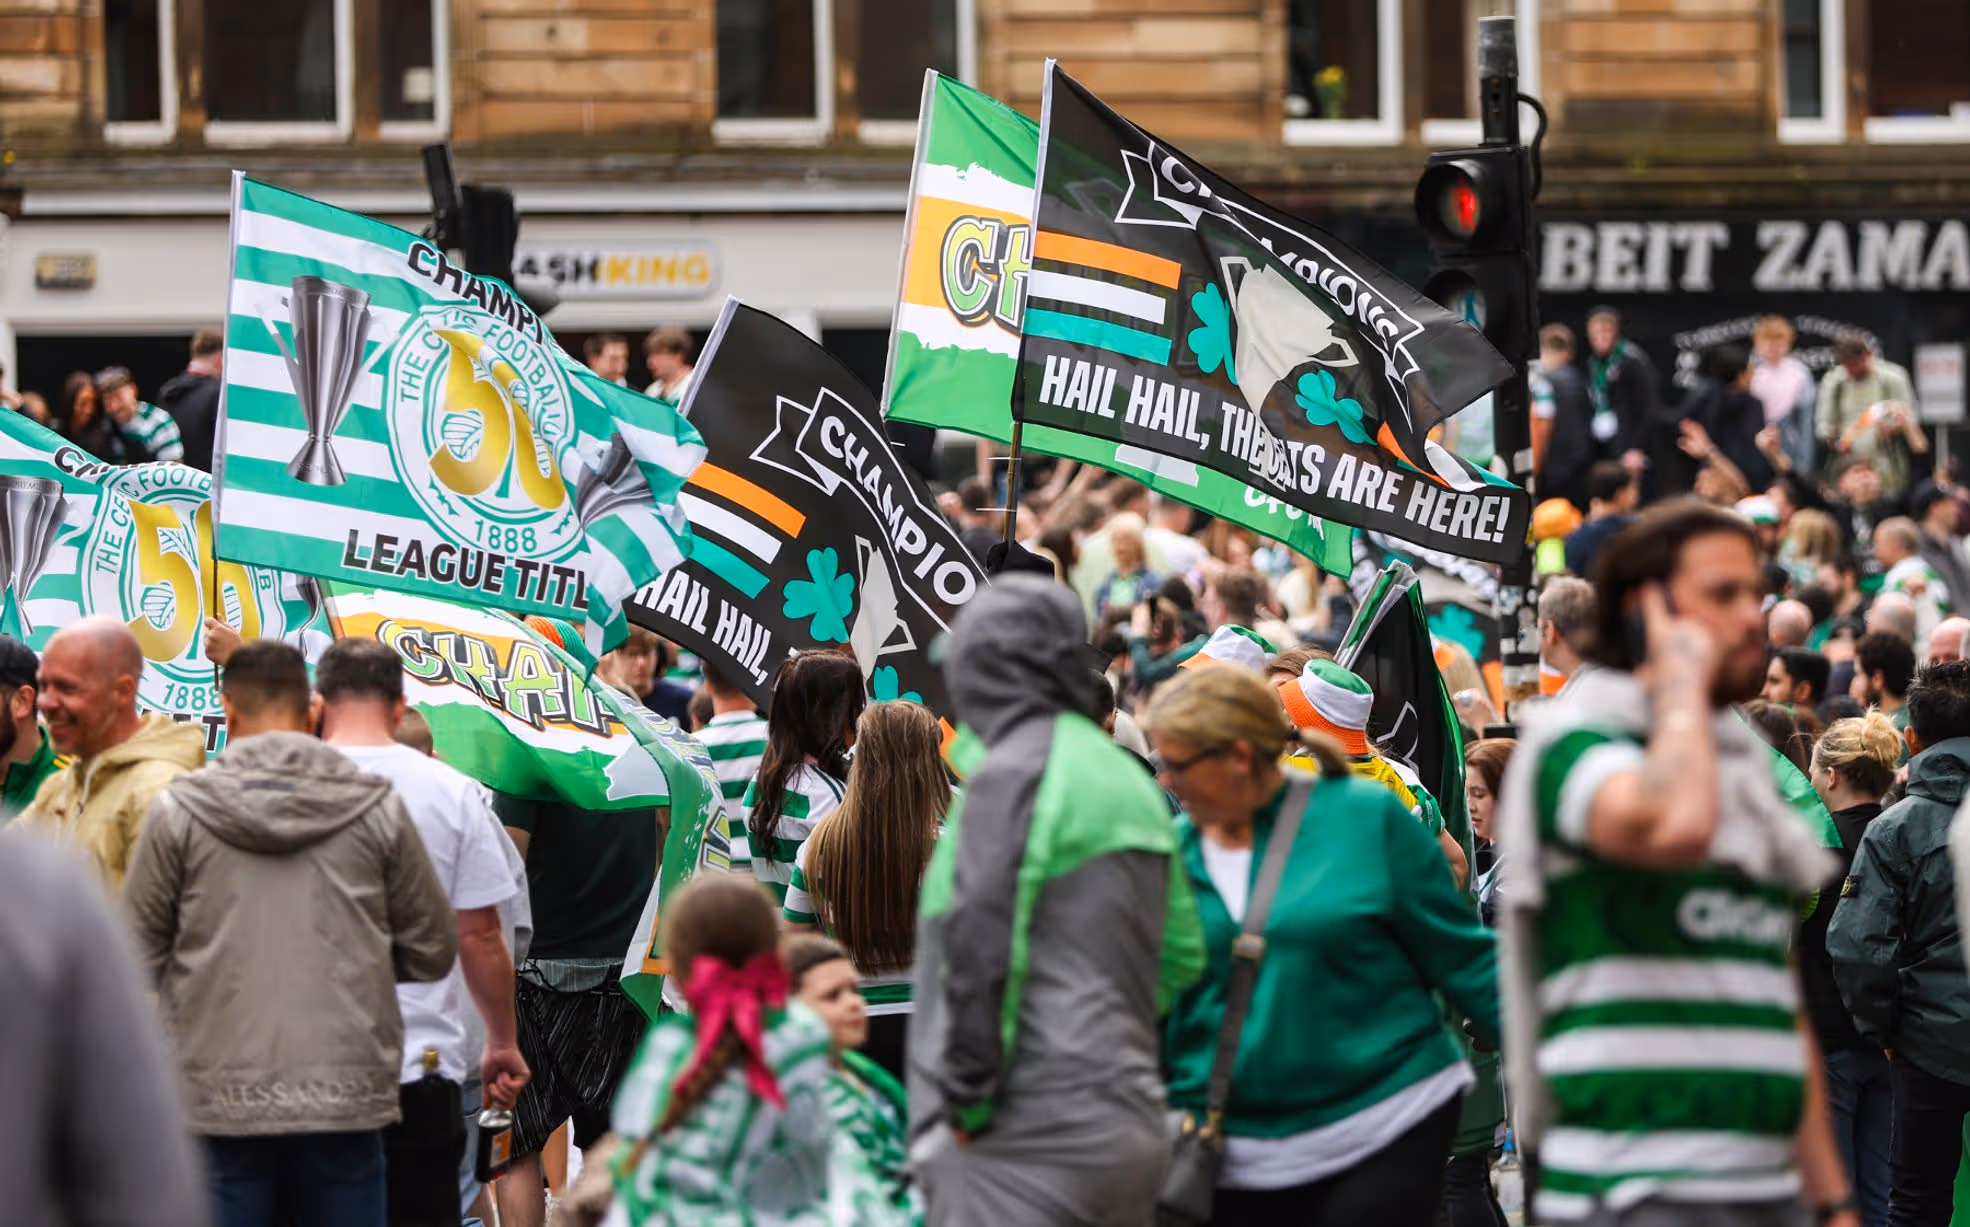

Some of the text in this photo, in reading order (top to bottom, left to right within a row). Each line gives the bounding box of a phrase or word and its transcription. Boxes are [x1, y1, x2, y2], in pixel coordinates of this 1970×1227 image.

[1538, 221, 1728, 292] BEIT
[401, 353, 431, 402] THE
[1039, 354, 1117, 419] HAIL
[1125, 374, 1210, 450] HAIL,
[1220, 401, 1265, 468] THE
[1327, 453, 1404, 514] ARE
[1405, 480, 1511, 544] HERE!
[475, 519, 538, 553] 1888
[820, 416, 977, 605] CHAMPIO
[96, 531, 122, 574] THE
[343, 529, 506, 593] LEAGUE
[633, 567, 771, 687] HAIL HAIL,
